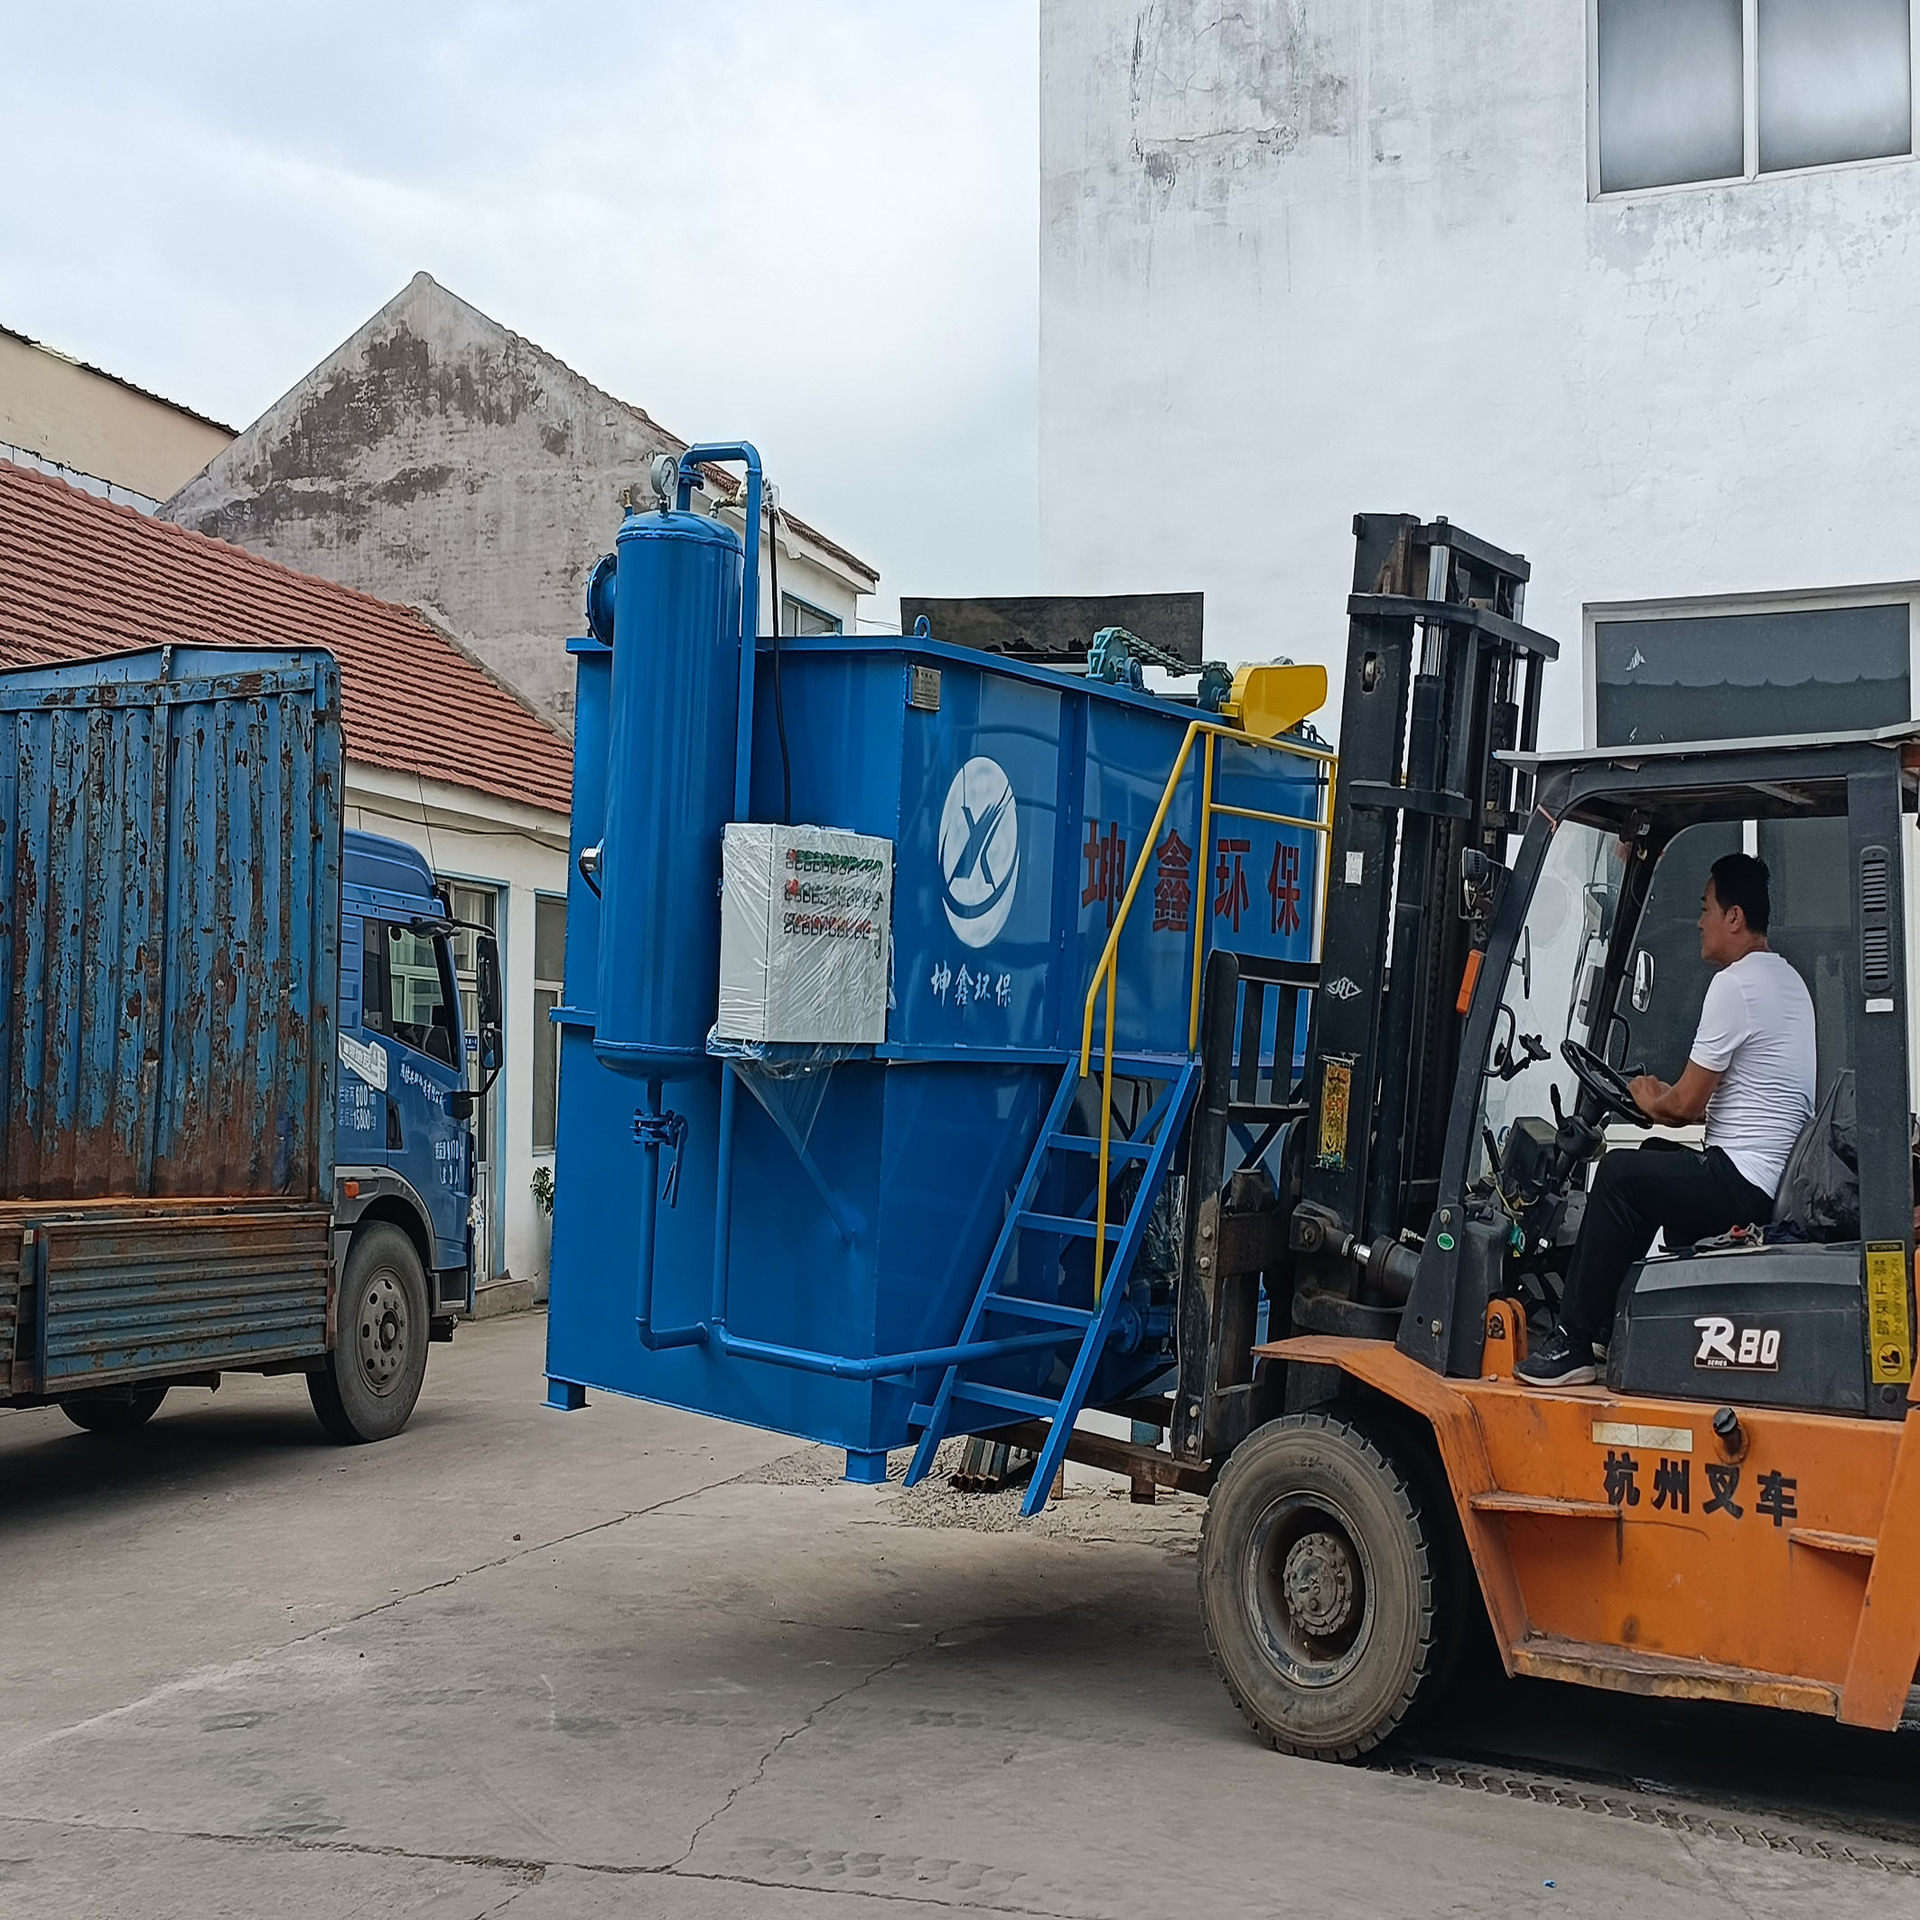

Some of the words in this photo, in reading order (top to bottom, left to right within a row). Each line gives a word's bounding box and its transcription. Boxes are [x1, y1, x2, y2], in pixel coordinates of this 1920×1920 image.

[1082, 819, 1301, 937] 坤鑫环保
[930, 959, 1012, 1008] 坤鑫环保
[1603, 1450, 1799, 1527] 杭州叉车
